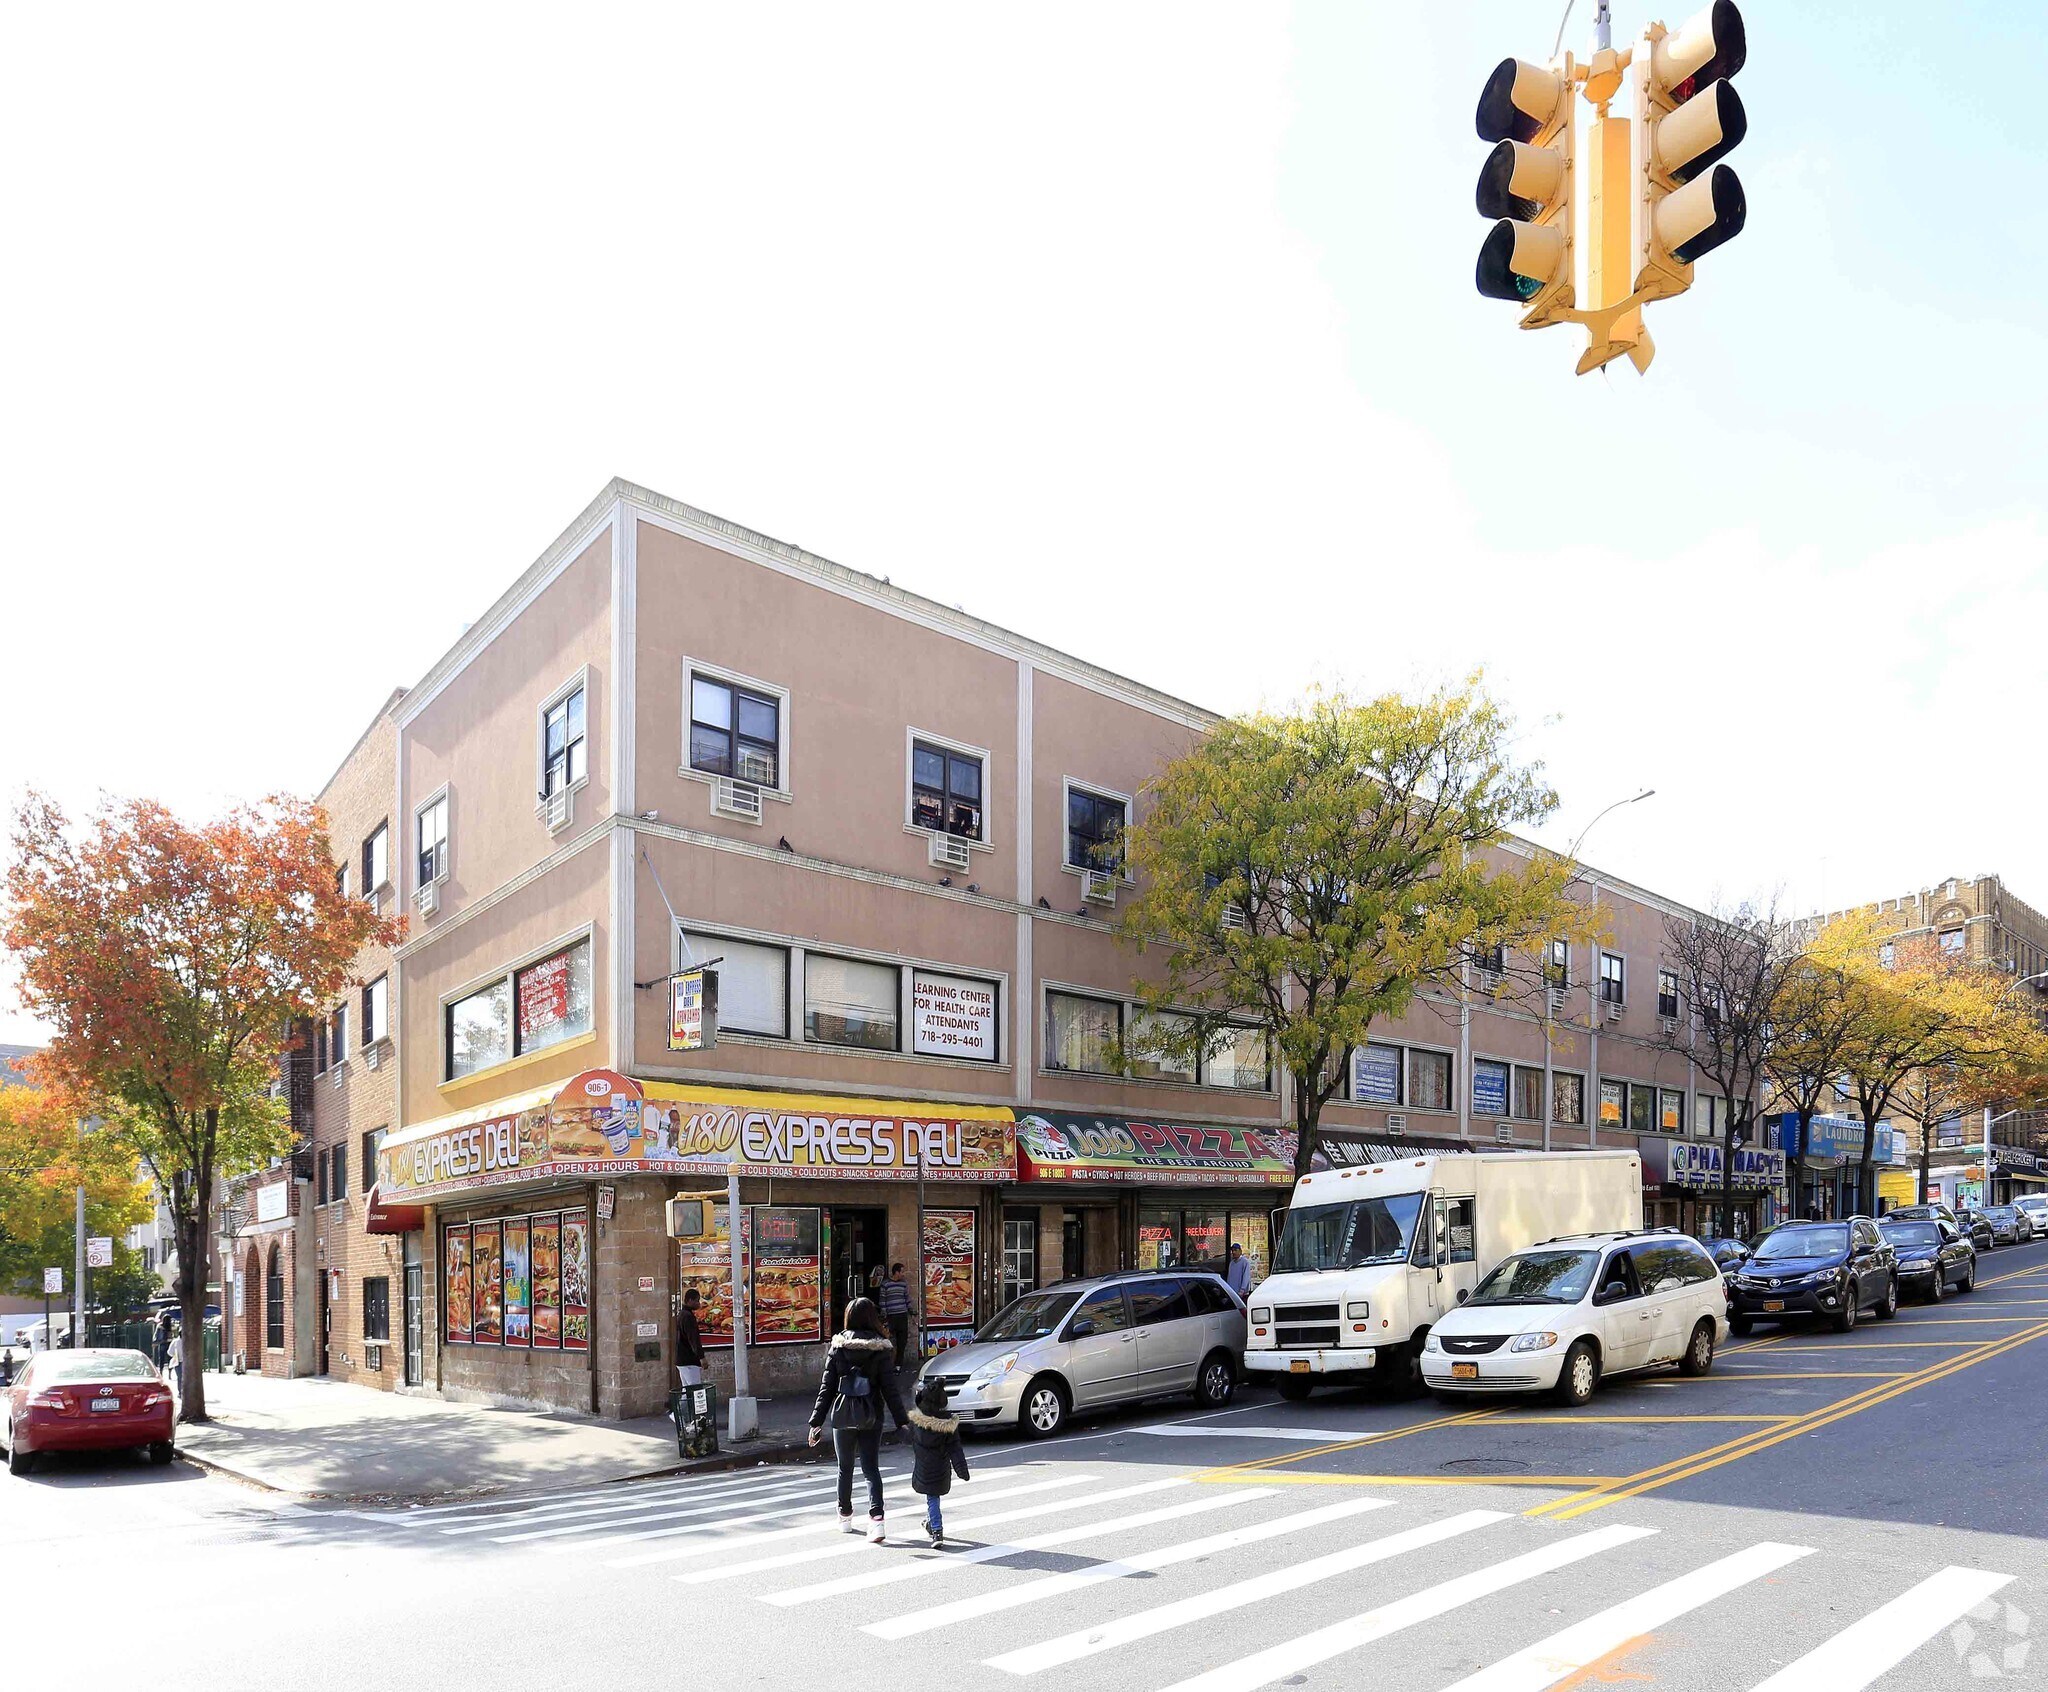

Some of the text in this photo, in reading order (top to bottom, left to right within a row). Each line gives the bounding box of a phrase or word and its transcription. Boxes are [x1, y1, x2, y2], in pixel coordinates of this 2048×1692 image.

[685, 978, 702, 996] EXPRESS
[914, 983, 991, 1004] LEARNING CENTER
[914, 998, 991, 1018] FOR HEALTH CARE
[925, 1014, 980, 1031] ATTENDANTS
[921, 1030, 983, 1048] 718-295-4401
[587, 1083, 608, 1093] 906-1
[679, 1109, 963, 1167] 180 EXPRESS DELI
[1126, 1122, 1283, 1161] PIZZA
[414, 1127, 482, 1184] EXPRESS
[485, 1117, 520, 1172] DELI
[1032, 1148, 1076, 1160] PIZZA
[556, 1161, 639, 1173] OPEN 24 HOURS
[1137, 1157, 1164, 1165] THE
[1203, 1160, 1250, 1168] AROUND
[1688, 1144, 1775, 1175] PHAMACY
[649, 1161, 664, 1170] HOT
[674, 1162, 695, 1172] COLD
[748, 1166, 768, 1175] COLD
[769, 1166, 793, 1176] SODAS
[799, 1168, 818, 1176] COLD
[819, 1168, 837, 1177] CUTS
[842, 1169, 869, 1178] SNACKS
[874, 1170, 895, 1178] CANDY
[942, 1170, 961, 1178] HALAL
[963, 1170, 979, 1178] FOOD
[983, 1170, 994, 1178] EBT
[1072, 1169, 1088, 1178] PASTA
[1092, 1170, 1110, 1180] GYROS
[1113, 1170, 1123, 1180] HOT
[1124, 1171, 1143, 1180] HEROES
[1146, 1172, 1158, 1180] BEEF
[1158, 1172, 1172, 1181] PATTY
[1176, 1173, 1198, 1182] CATERING
[1201, 1173, 1215, 1182] TACOS
[1238, 1174, 1265, 1183] QUESADILLAS
[1269, 1175, 1281, 1183] FREE
[762, 1220, 798, 1238] DELI
[1139, 1227, 1225, 1240] PIZZA FREE DELIVERY
[760, 1257, 811, 1265] Sandwiches
